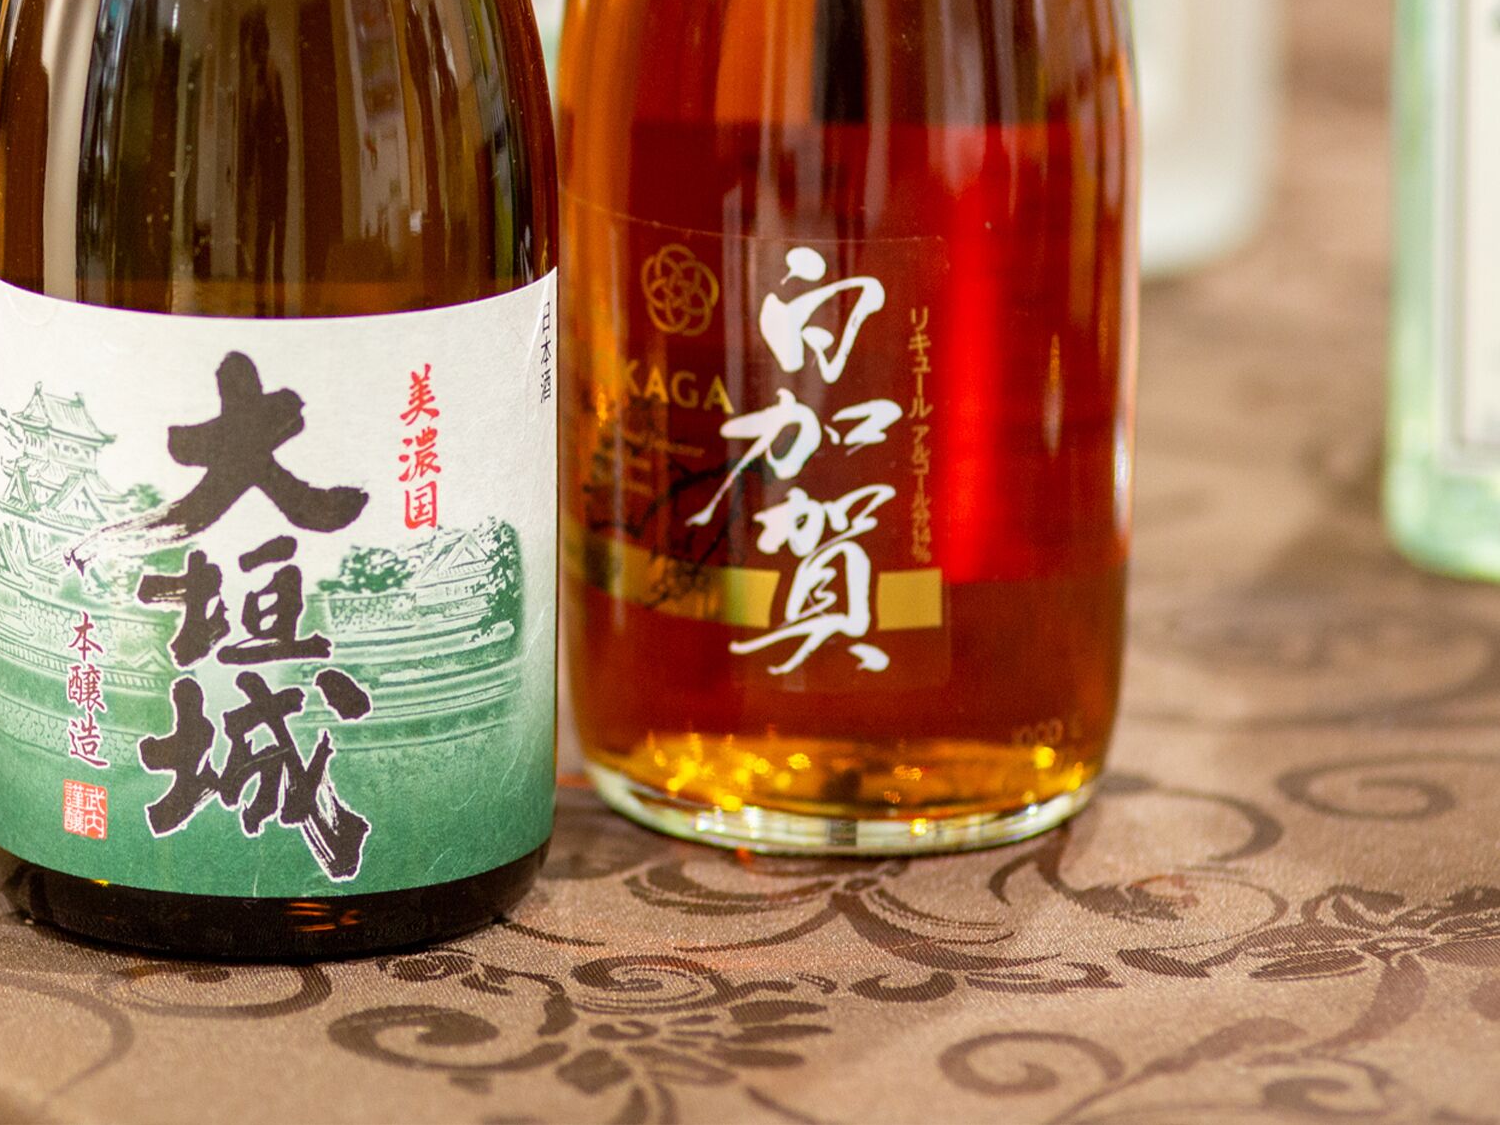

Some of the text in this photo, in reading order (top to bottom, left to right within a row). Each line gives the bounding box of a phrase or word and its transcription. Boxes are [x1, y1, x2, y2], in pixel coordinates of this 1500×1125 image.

[539, 300, 552, 405] 日本酒
[907, 306, 934, 419] リキュール
[398, 362, 442, 530] 美濃国
[686, 246, 903, 675] 白加賀
[67, 610, 110, 767] 本醸造
[137, 350, 373, 882] 大垣城
